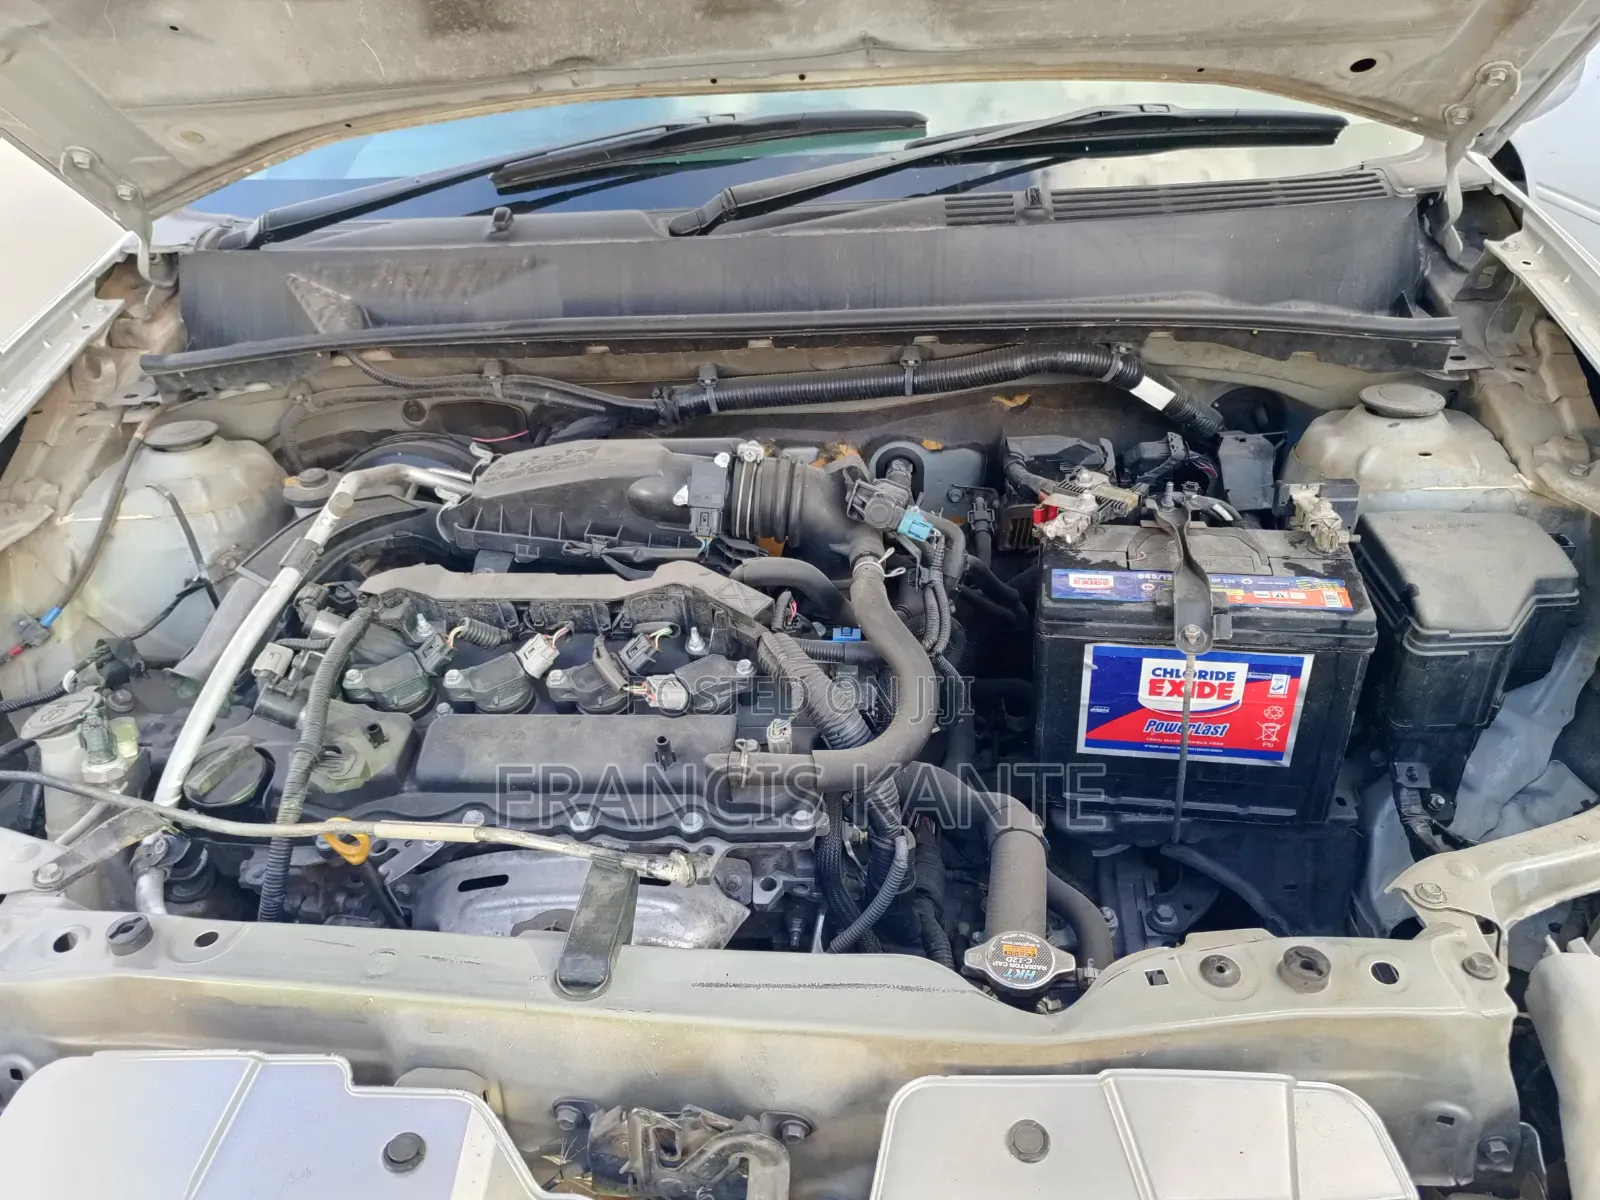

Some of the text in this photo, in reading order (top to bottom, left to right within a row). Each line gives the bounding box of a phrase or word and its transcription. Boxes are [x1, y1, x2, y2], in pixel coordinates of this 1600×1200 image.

[1148, 678, 1235, 700] EXIDE
[1009, 963, 1048, 971] RADIATOR
[1004, 969, 1036, 981] HKT
